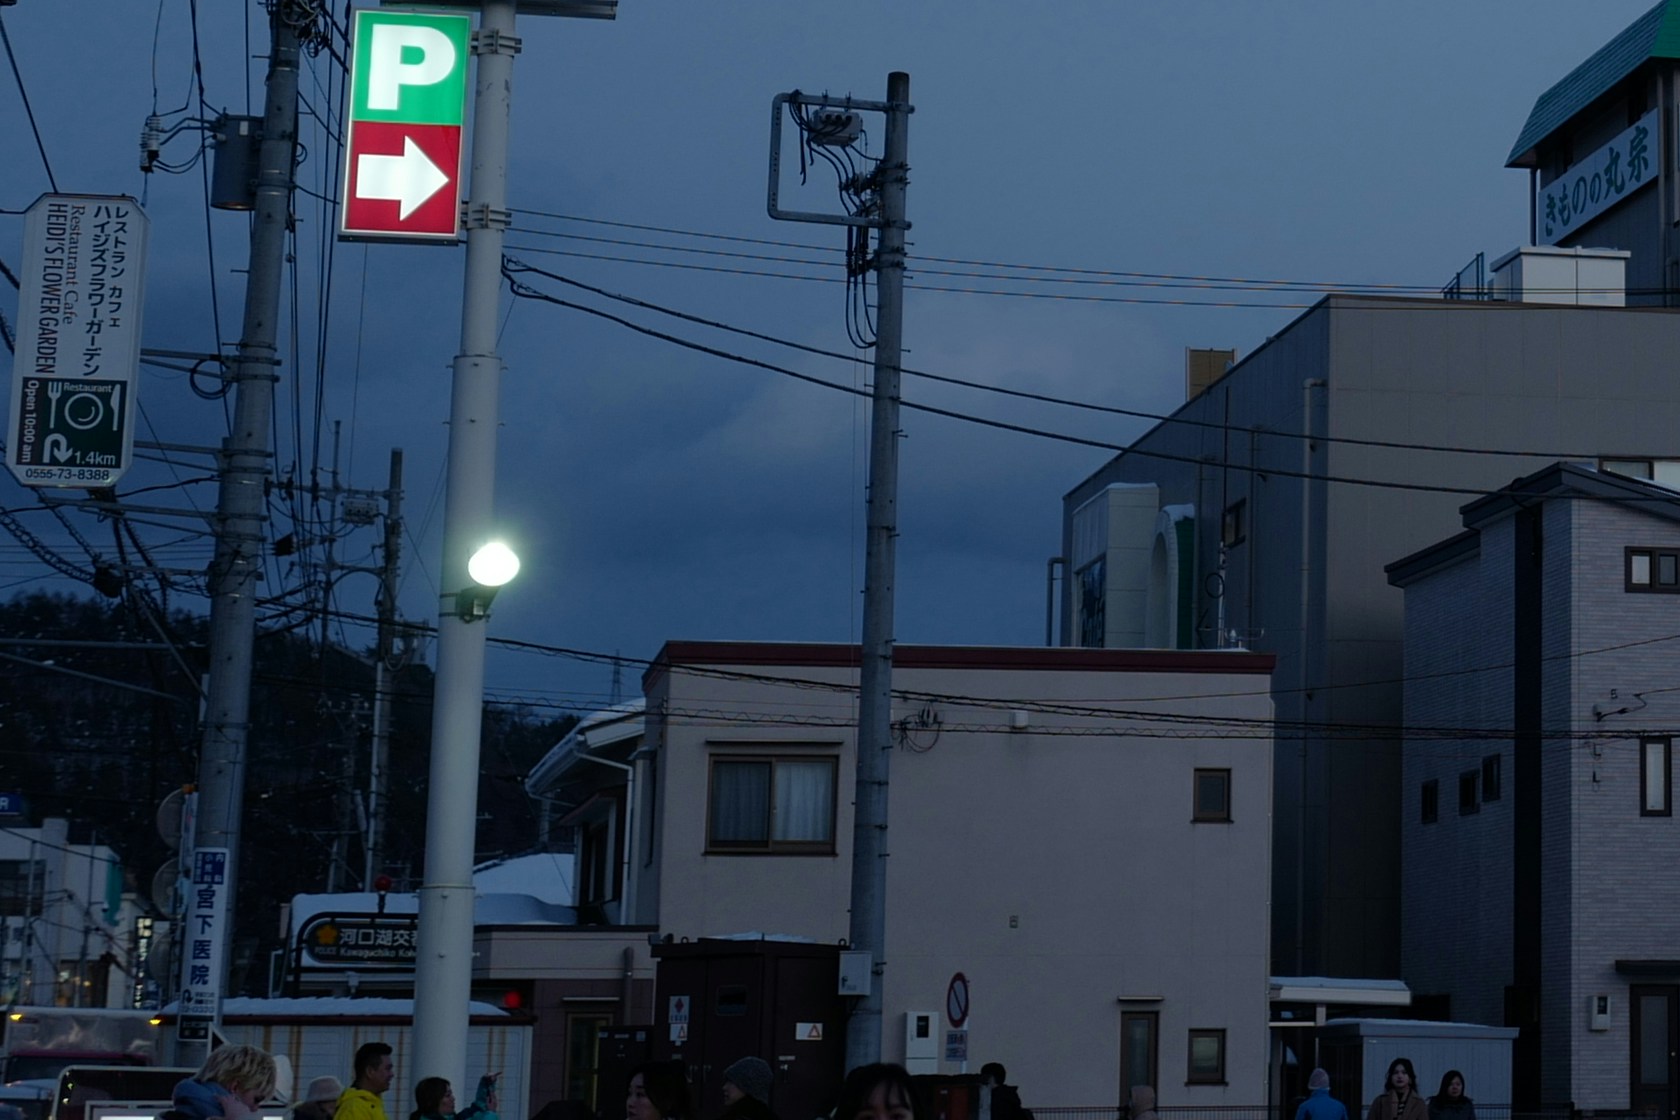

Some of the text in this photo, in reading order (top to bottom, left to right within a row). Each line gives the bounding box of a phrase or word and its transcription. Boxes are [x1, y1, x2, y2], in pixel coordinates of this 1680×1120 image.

[367, 23, 456, 111] P
[40, 257, 64, 314] FLOWER
[65, 205, 86, 287] Restaurant
[108, 205, 129, 327] レストラン カフェ
[82, 205, 111, 377] ハイジズフラワーガーデン
[35, 317, 60, 374] GARDEN
[20, 380, 40, 463] Open 10:00 am
[63, 381, 114, 393] Restaurant
[25, 468, 111, 480] 0555-73-8388
[74, 451, 117, 467] 1.4km
[190, 884, 216, 985] 宮下医院
